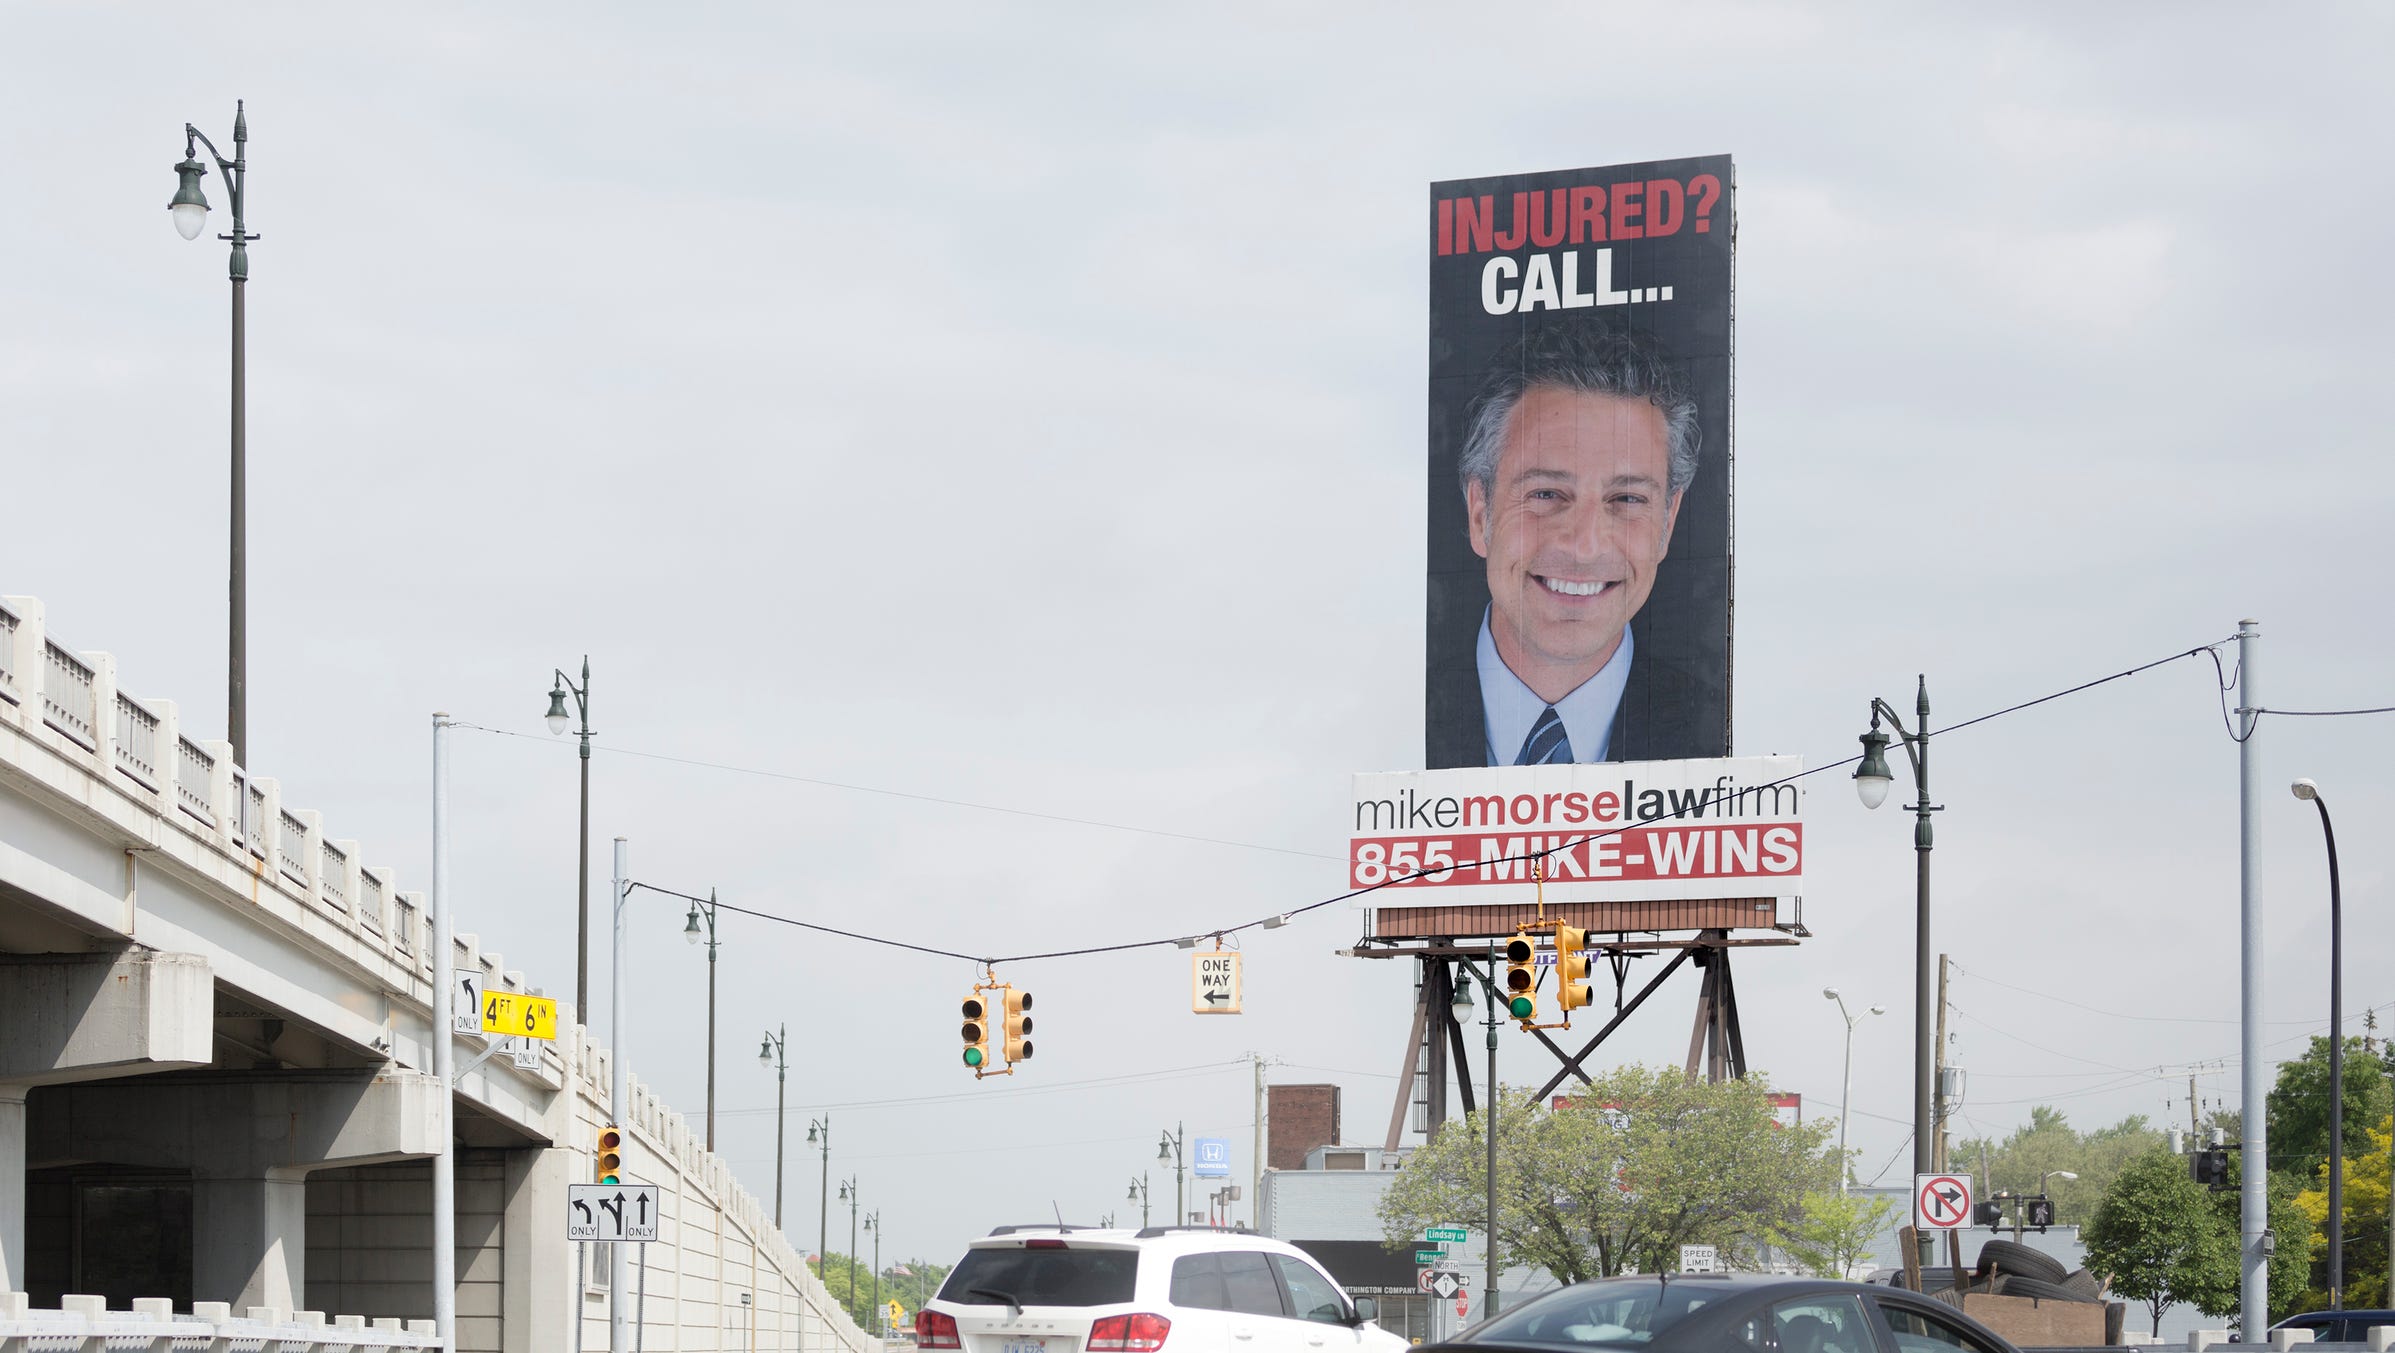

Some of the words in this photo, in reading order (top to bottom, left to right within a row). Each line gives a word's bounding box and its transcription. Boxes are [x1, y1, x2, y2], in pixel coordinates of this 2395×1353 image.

[1438, 173, 1721, 256] INJURED?
[1481, 248, 1673, 316] CALL...
[1355, 827, 1798, 886] 855-MIKE-WINS
[1202, 959, 1231, 972] ONE
[1202, 974, 1231, 987] WAY
[499, 998, 511, 1014] FT
[525, 1004, 535, 1031] 6
[538, 1004, 547, 1019] IN
[457, 1016, 478, 1030] ONLY
[517, 1052, 536, 1065] ONLY
[571, 1226, 597, 1236] ONLY
[628, 1227, 654, 1237] ONLY
[1428, 1229, 1457, 1242] Lindsay
[1683, 1249, 1713, 1258] SPEED
[1434, 1260, 1459, 1270] NORTH
[1686, 1259, 1709, 1267] LIMIT
[1383, 1286, 1417, 1295] COMPANY
